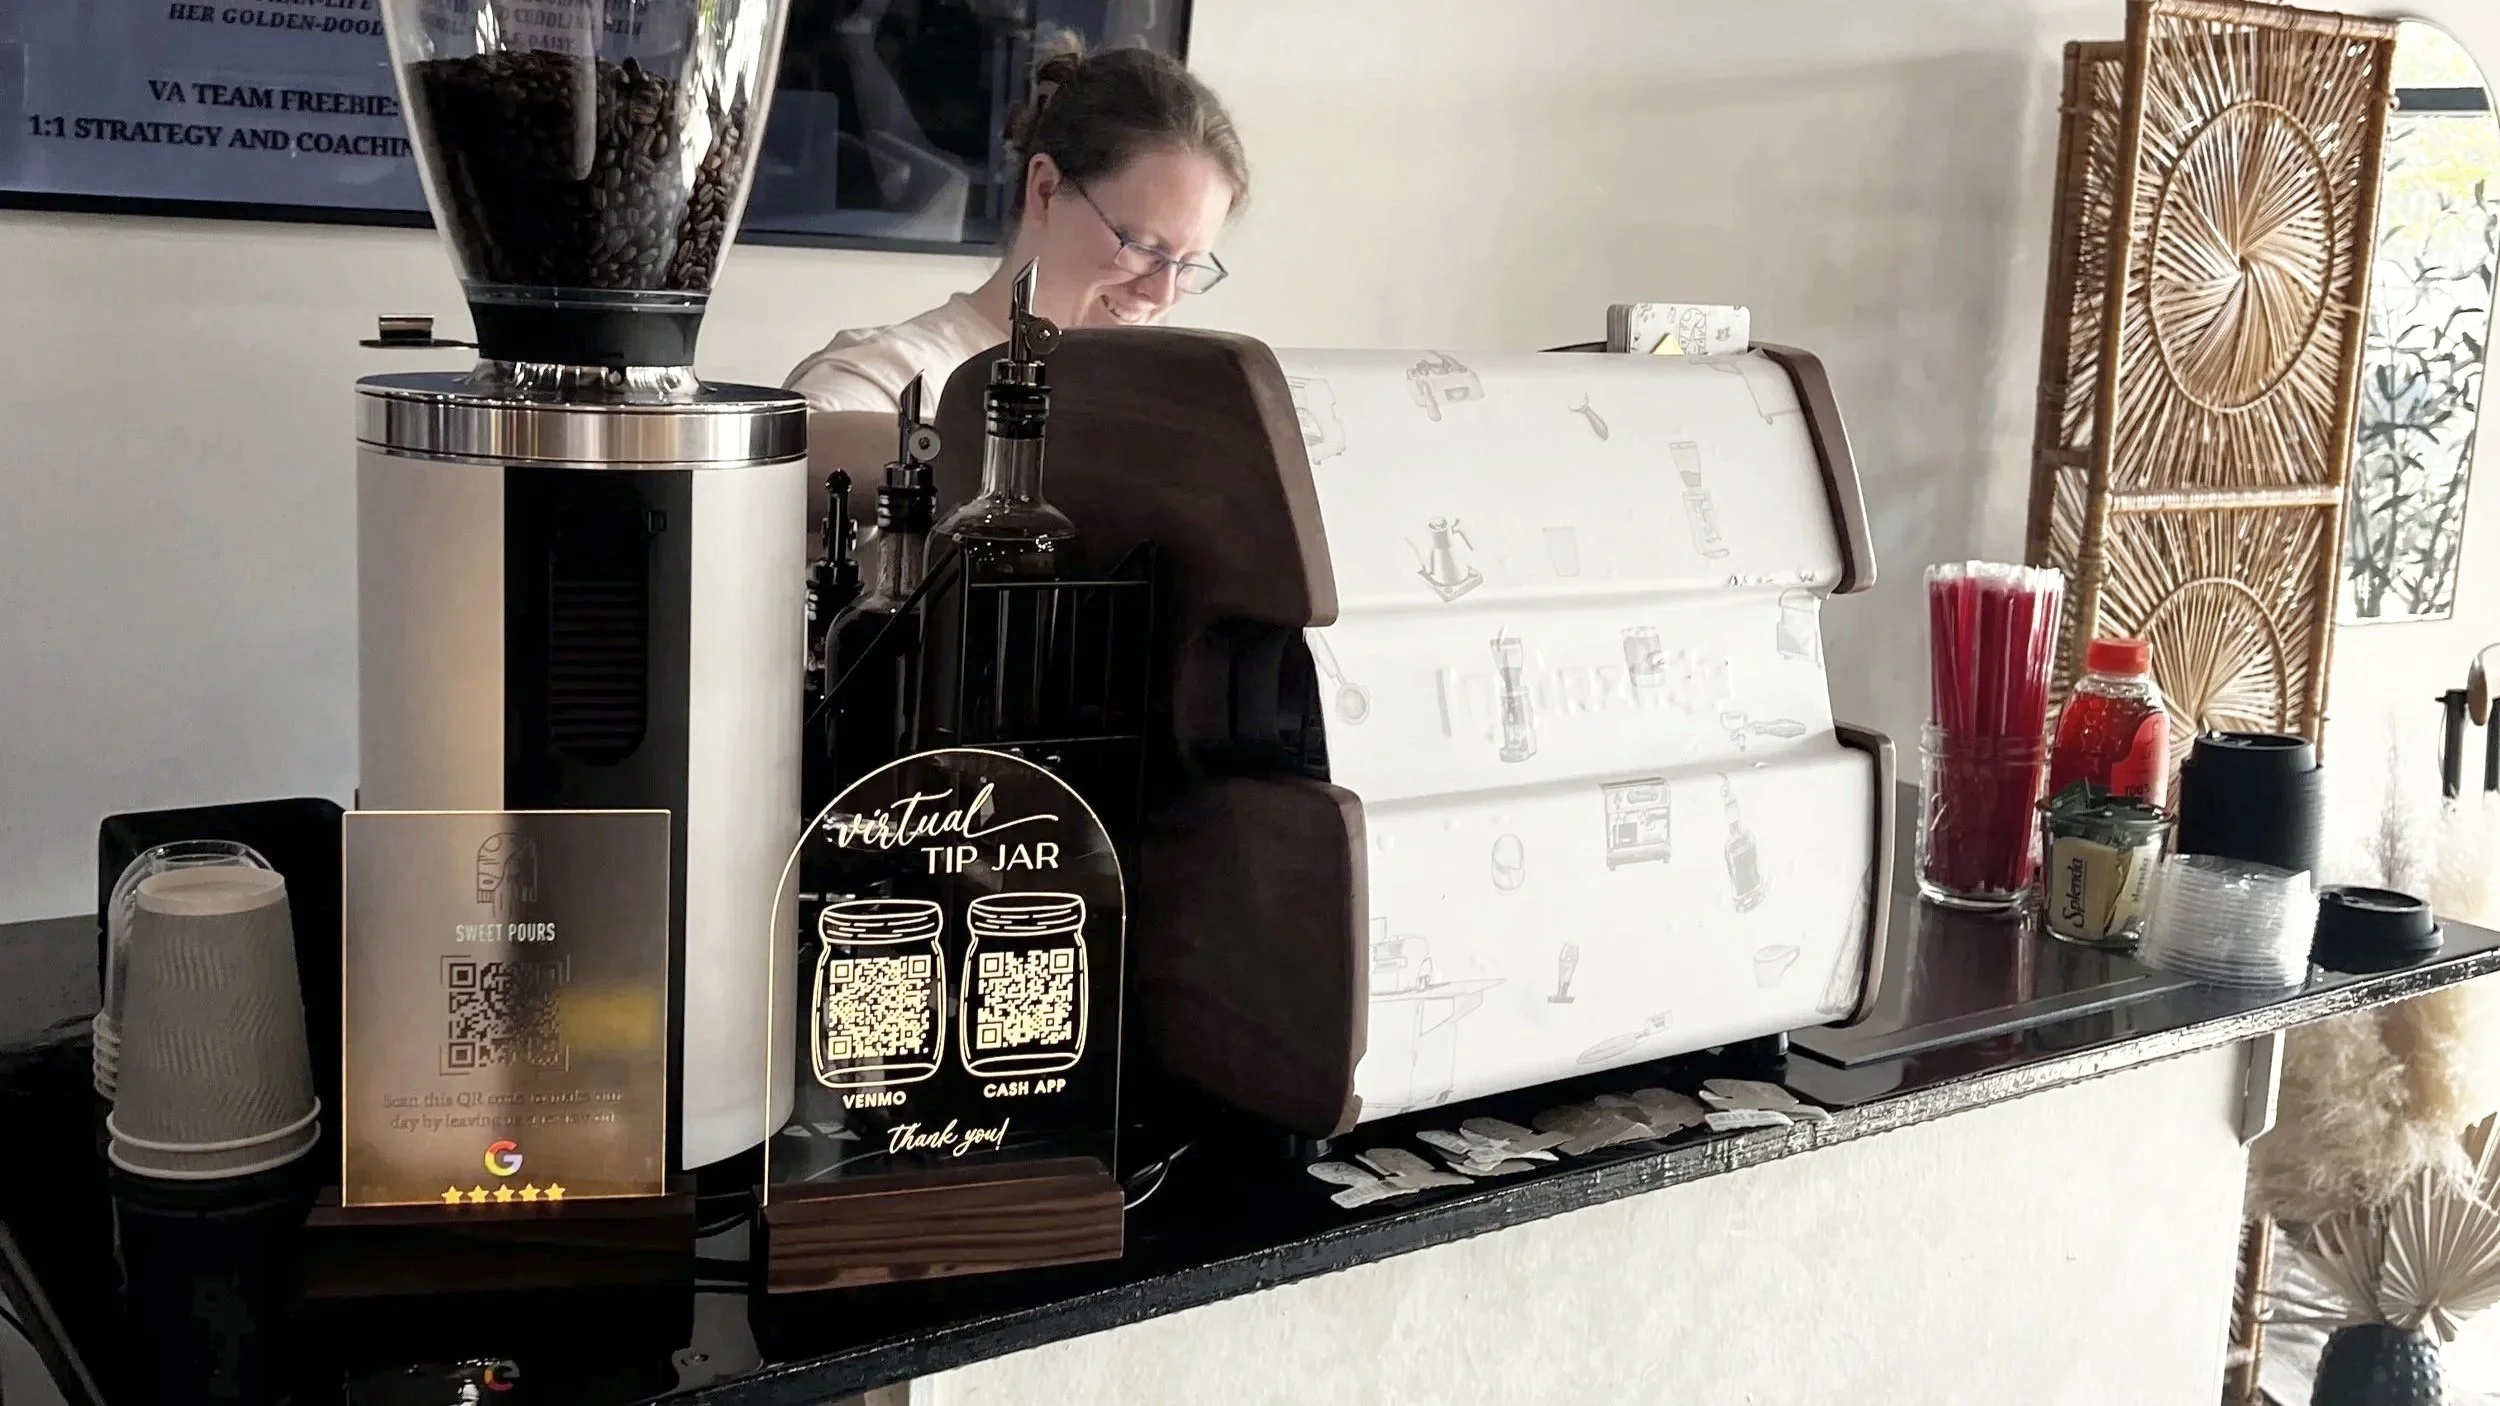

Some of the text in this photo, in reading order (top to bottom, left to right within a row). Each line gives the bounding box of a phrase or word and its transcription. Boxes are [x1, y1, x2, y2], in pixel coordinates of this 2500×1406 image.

[168, 3, 214, 23] HER
[148, 79, 400, 117] VA TEAM FREEBIE:
[28, 113, 64, 137] 1:1
[74, 116, 223, 147] STRATEGY
[228, 128, 290, 152] AND
[838, 783, 1059, 849] virtual
[921, 842, 1060, 874] TIP JAR
[2062, 857, 2085, 928] Splenda
[456, 922, 556, 942] SWEET POURS
[842, 1091, 907, 1110] VENMO
[983, 1079, 1067, 1099] CASH APP
